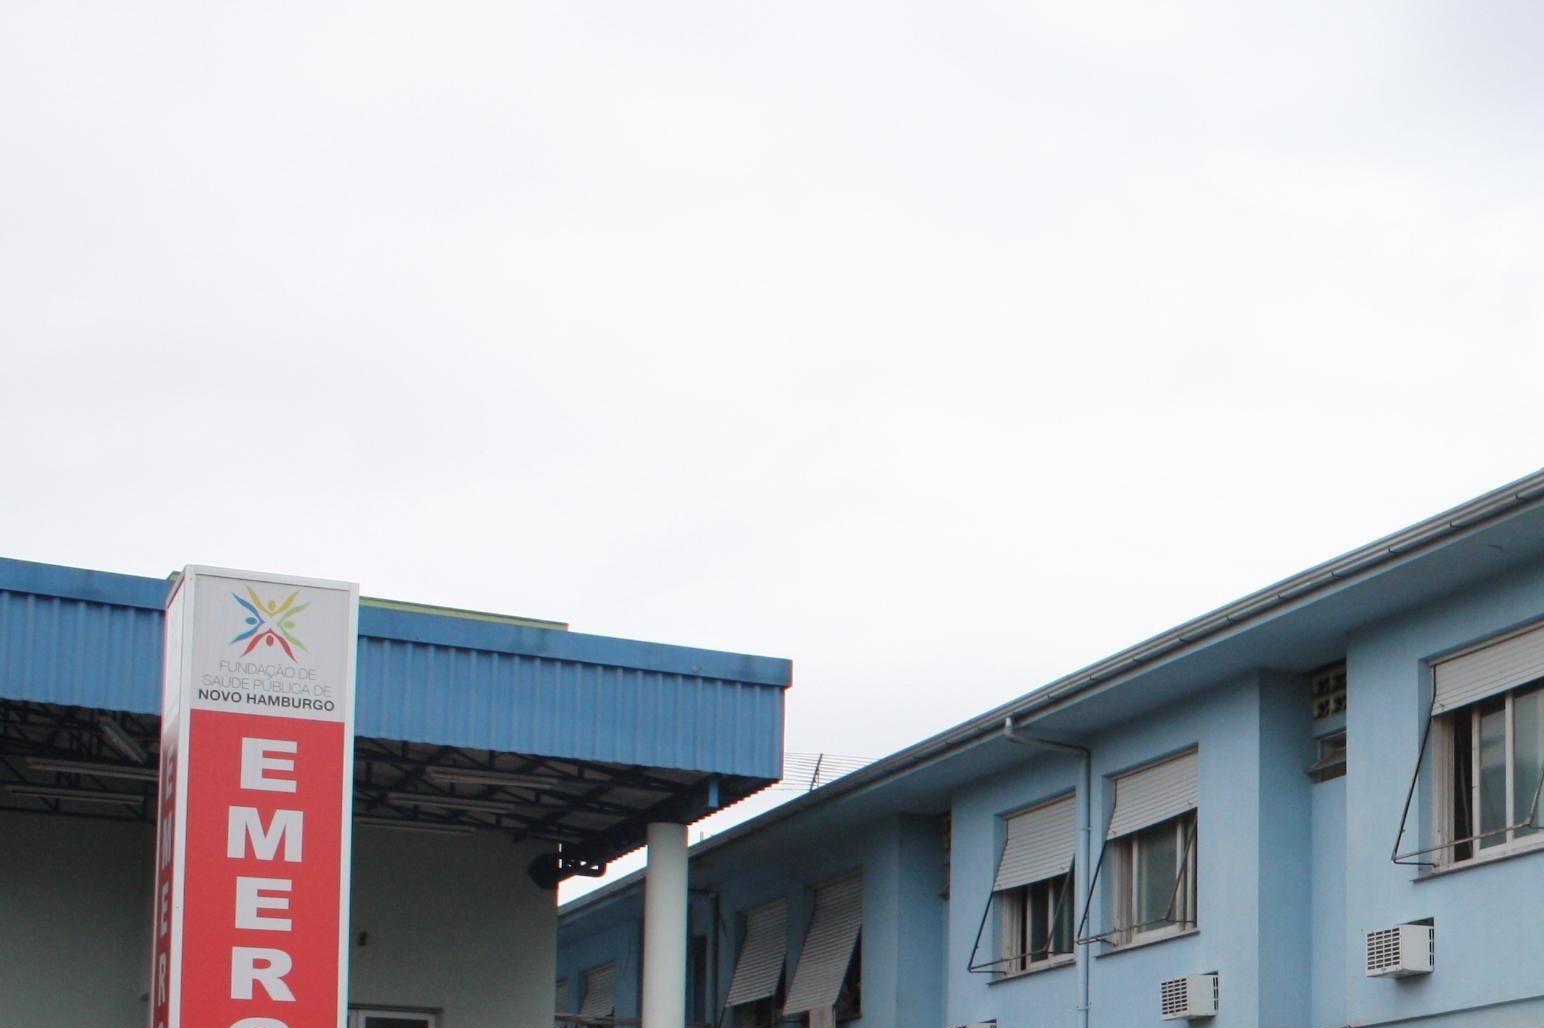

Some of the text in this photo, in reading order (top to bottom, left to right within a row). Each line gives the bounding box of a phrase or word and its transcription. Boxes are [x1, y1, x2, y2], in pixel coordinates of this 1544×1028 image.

[219, 660, 317, 681] FUNDAÇÃO DE
[202, 673, 332, 698] SAÚDE PÚBLICA DE
[198, 688, 335, 712] NOVO HAMBURGO
